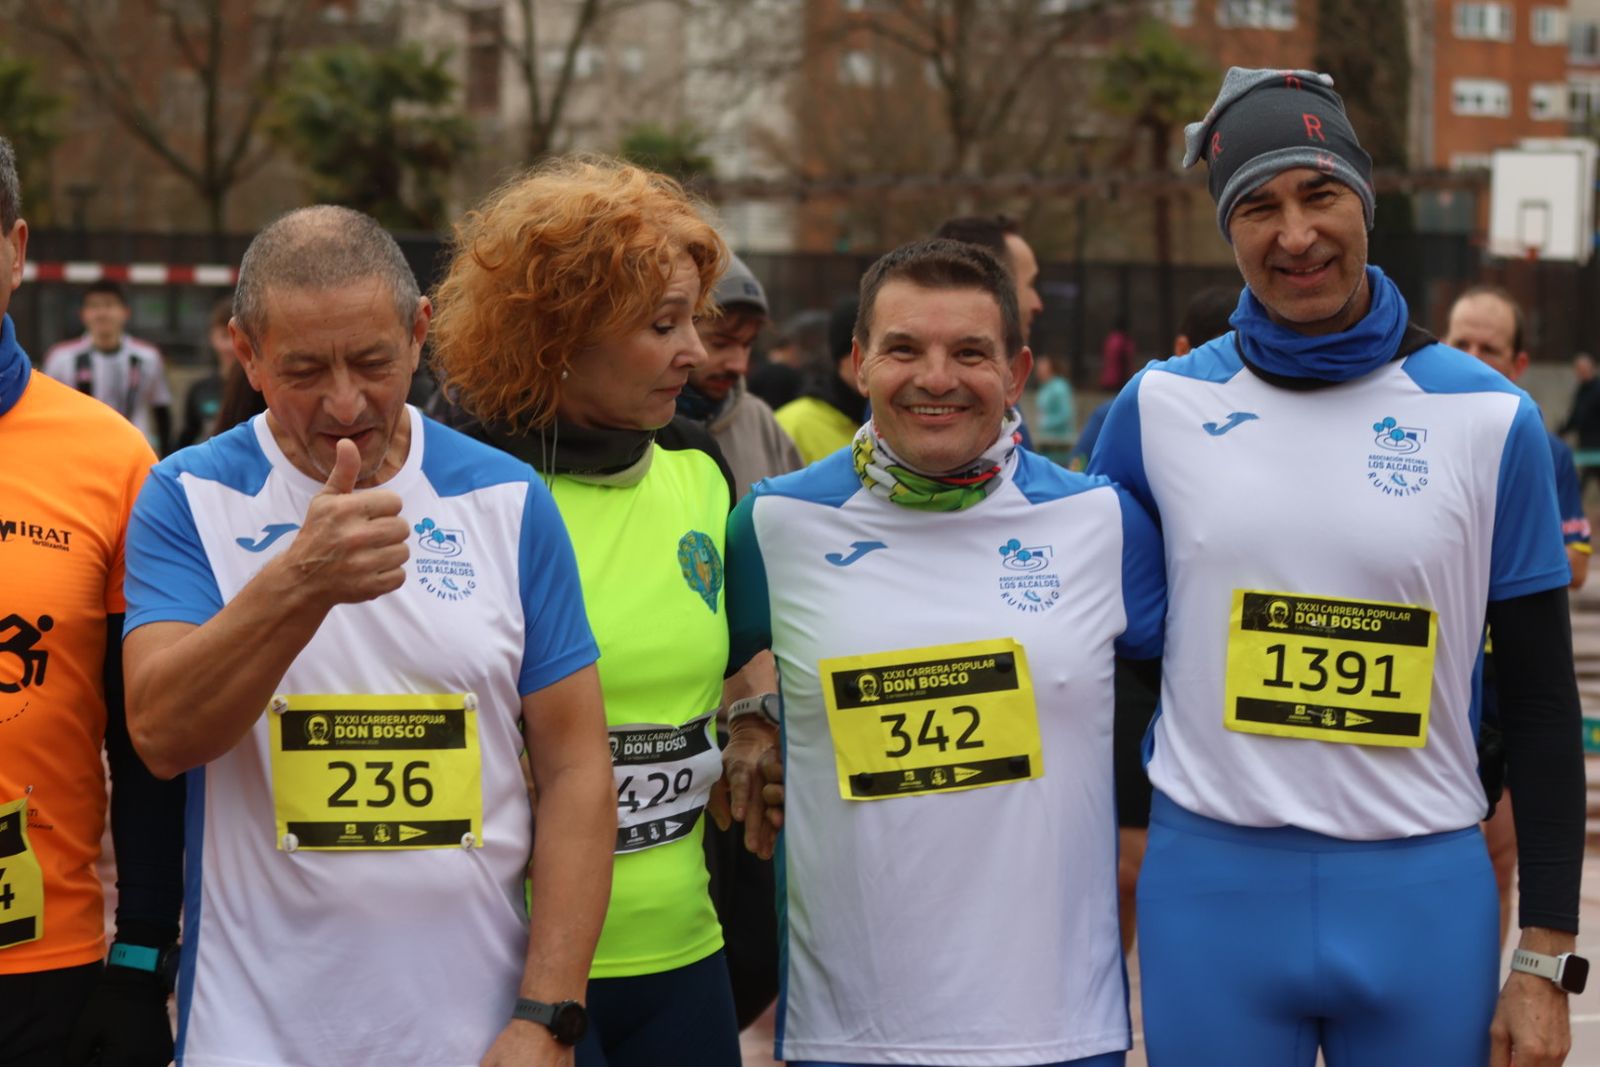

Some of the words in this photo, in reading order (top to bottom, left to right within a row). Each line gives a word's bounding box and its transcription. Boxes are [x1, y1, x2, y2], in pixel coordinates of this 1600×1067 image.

[1302, 113, 1326, 141] R
[1368, 461, 1384, 469] LOS
[1386, 462, 1429, 475] ALCALDES
[1367, 471, 1428, 497] RUNNING
[417, 565, 433, 573] LOS
[435, 566, 474, 577] ALCALDES
[419, 576, 476, 601] RUNNING
[1017, 580, 1060, 588] ALCALDES
[1000, 591, 1060, 612] RUNNING
[1296, 602, 1319, 612] XXXI
[1322, 604, 1365, 617] CARRERA
[1366, 608, 1411, 621] POPULAR
[1295, 612, 1327, 627] DON
[1331, 615, 1382, 632] BOSCO
[882, 671, 905, 681] XXXI
[906, 664, 950, 677] CARRERA
[952, 658, 995, 671] POPULAR
[1263, 643, 1401, 699] 1391
[883, 680, 915, 694] DON
[919, 671, 969, 690] BOSCO
[335, 715, 359, 724] XXXI
[360, 715, 407, 724] CARRERA
[334, 725, 368, 738] DON
[373, 725, 425, 738] BOSCO
[880, 705, 985, 759] 342
[624, 742, 652, 755] DON
[327, 761, 433, 808] 236
